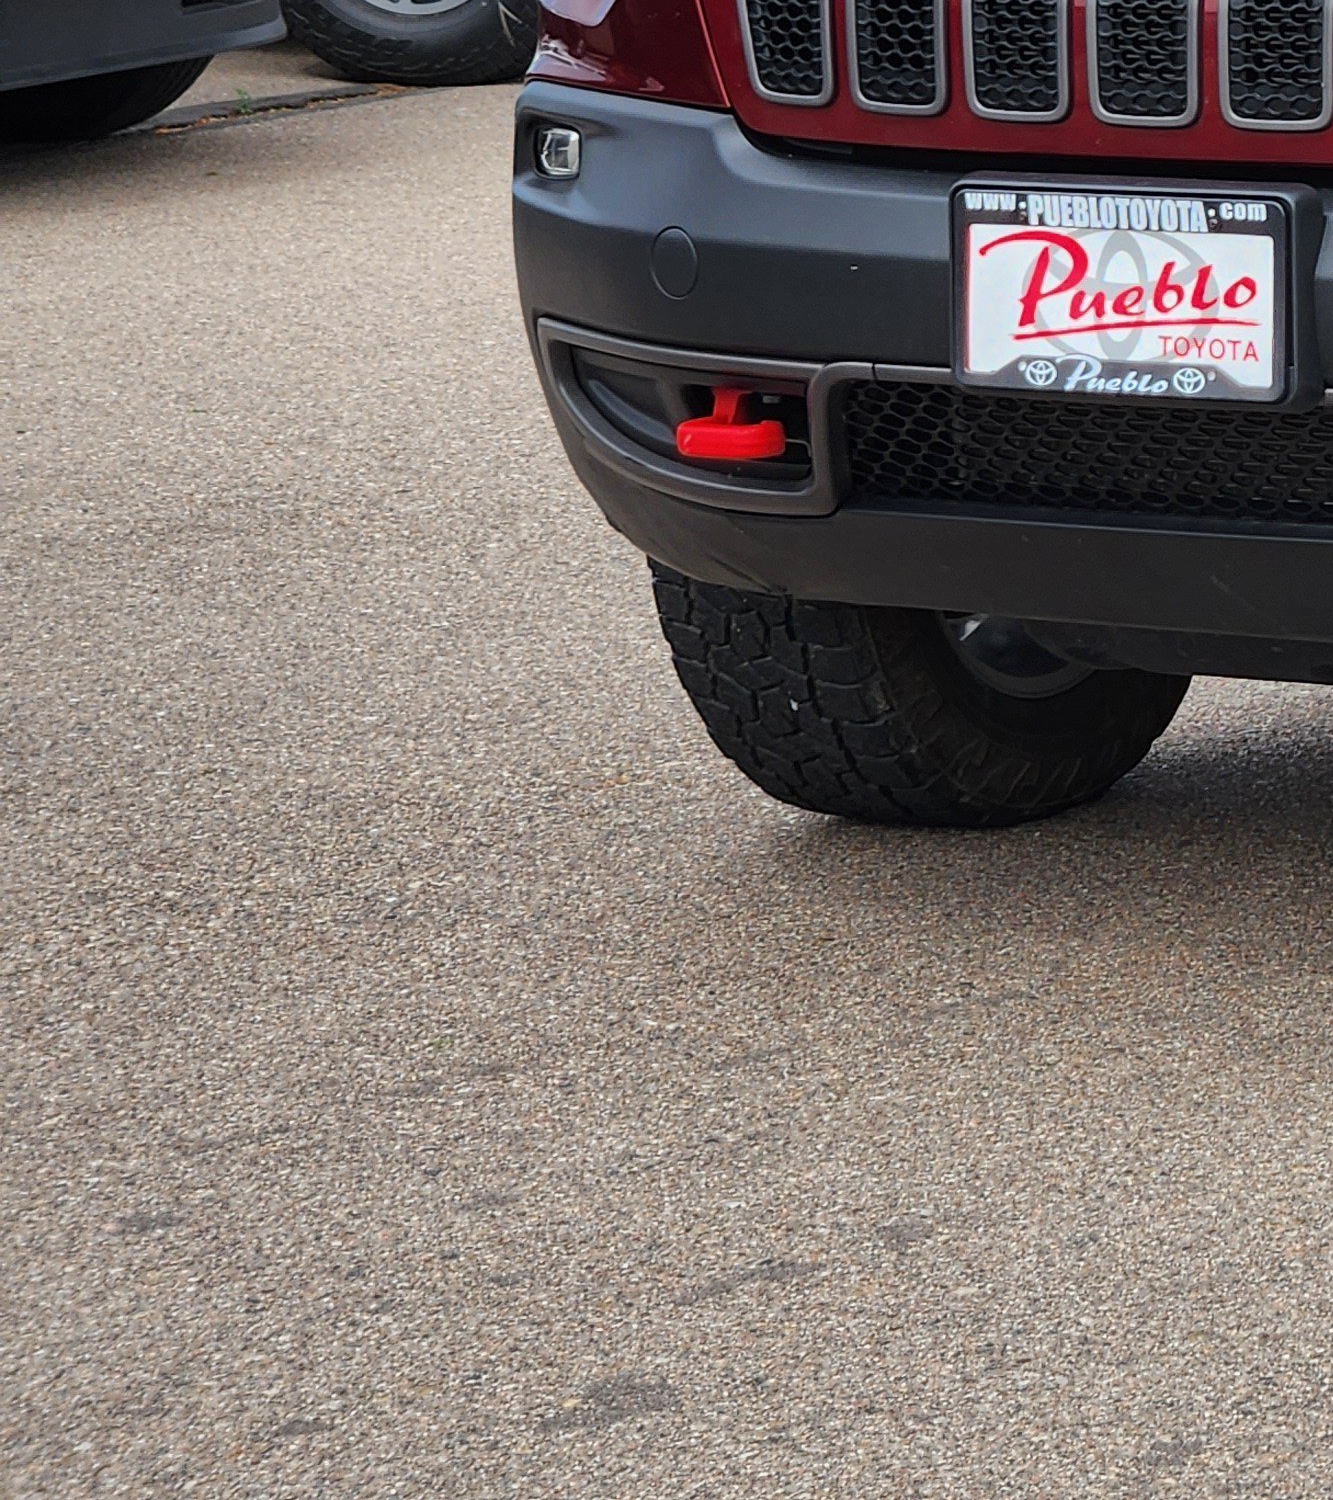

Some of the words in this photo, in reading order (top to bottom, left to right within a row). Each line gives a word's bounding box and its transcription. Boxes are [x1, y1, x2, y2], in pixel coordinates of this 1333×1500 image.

[979, 231, 1258, 327] Pueblo
[1158, 335, 1259, 362] TOYOTA
[1055, 354, 1169, 395] Pueblo
